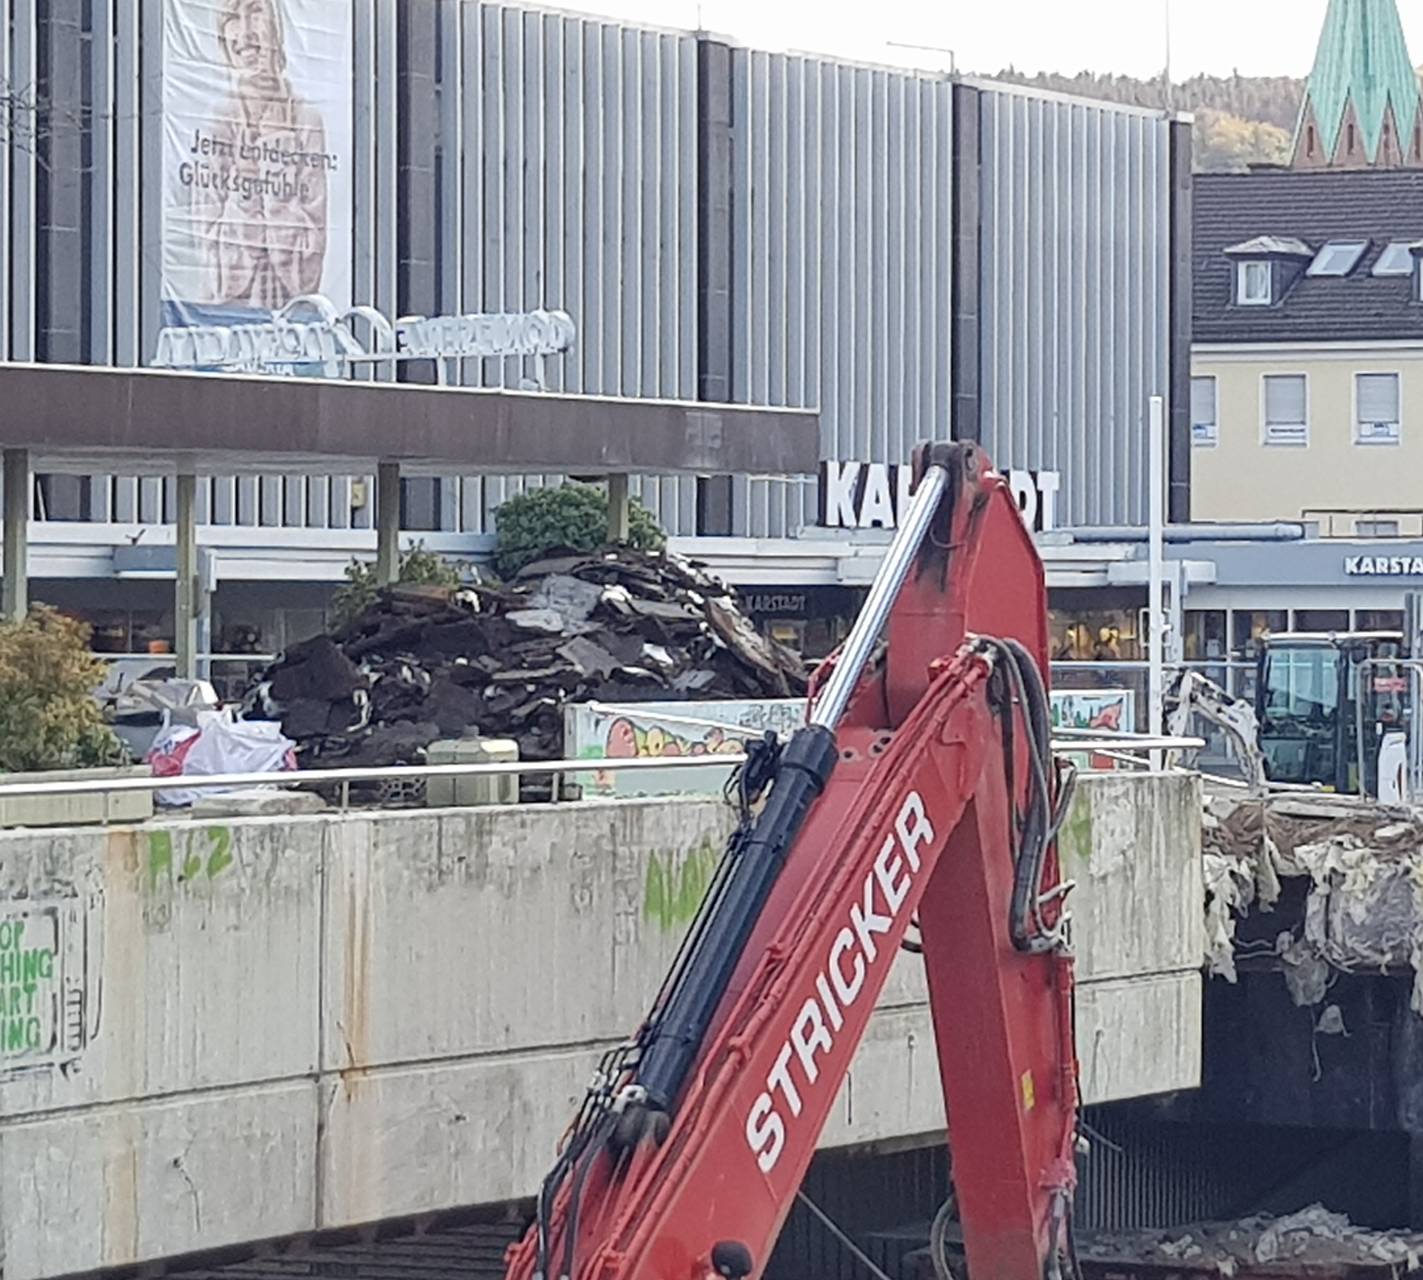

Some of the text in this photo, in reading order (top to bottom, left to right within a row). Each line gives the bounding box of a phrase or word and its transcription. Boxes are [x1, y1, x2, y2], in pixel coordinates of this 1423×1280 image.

[179, 161, 310, 200] Glücksgefühle
[826, 460, 1060, 532] KADT
[746, 790, 934, 1173] STRICKER
